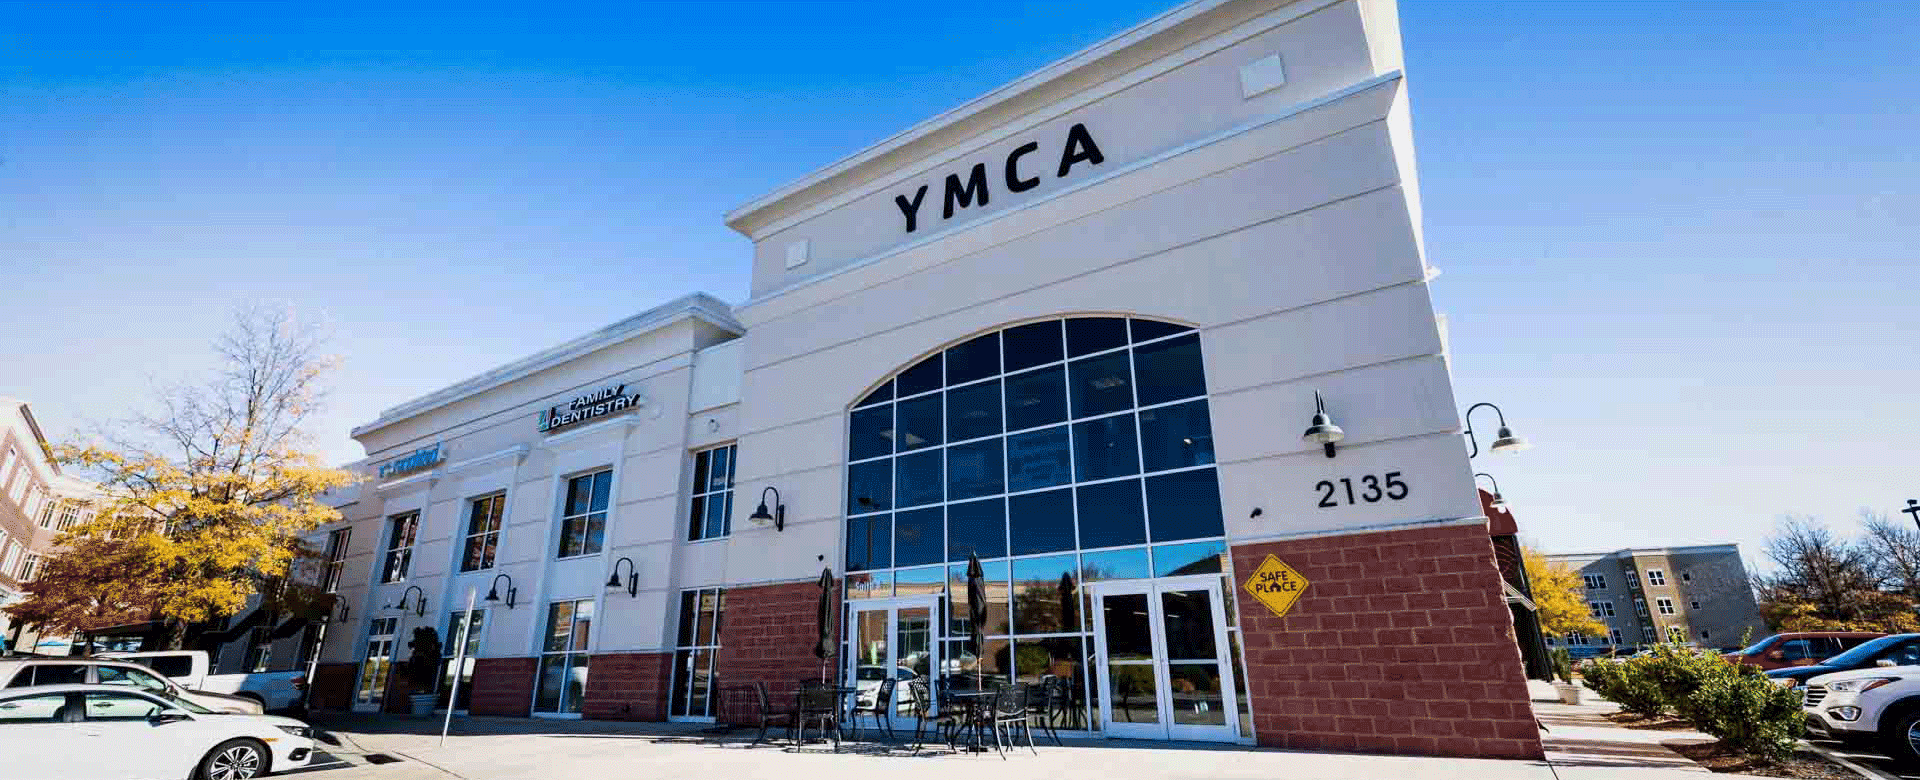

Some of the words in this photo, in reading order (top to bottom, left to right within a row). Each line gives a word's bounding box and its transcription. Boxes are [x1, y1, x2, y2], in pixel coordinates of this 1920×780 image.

[895, 122, 1105, 233] YMCA
[550, 393, 638, 429] DENTISTRY
[568, 385, 622, 411] FAMILY
[1315, 471, 1409, 508] 2135
[1255, 581, 1297, 594] PLACE
[1260, 570, 1289, 582] SAFE
